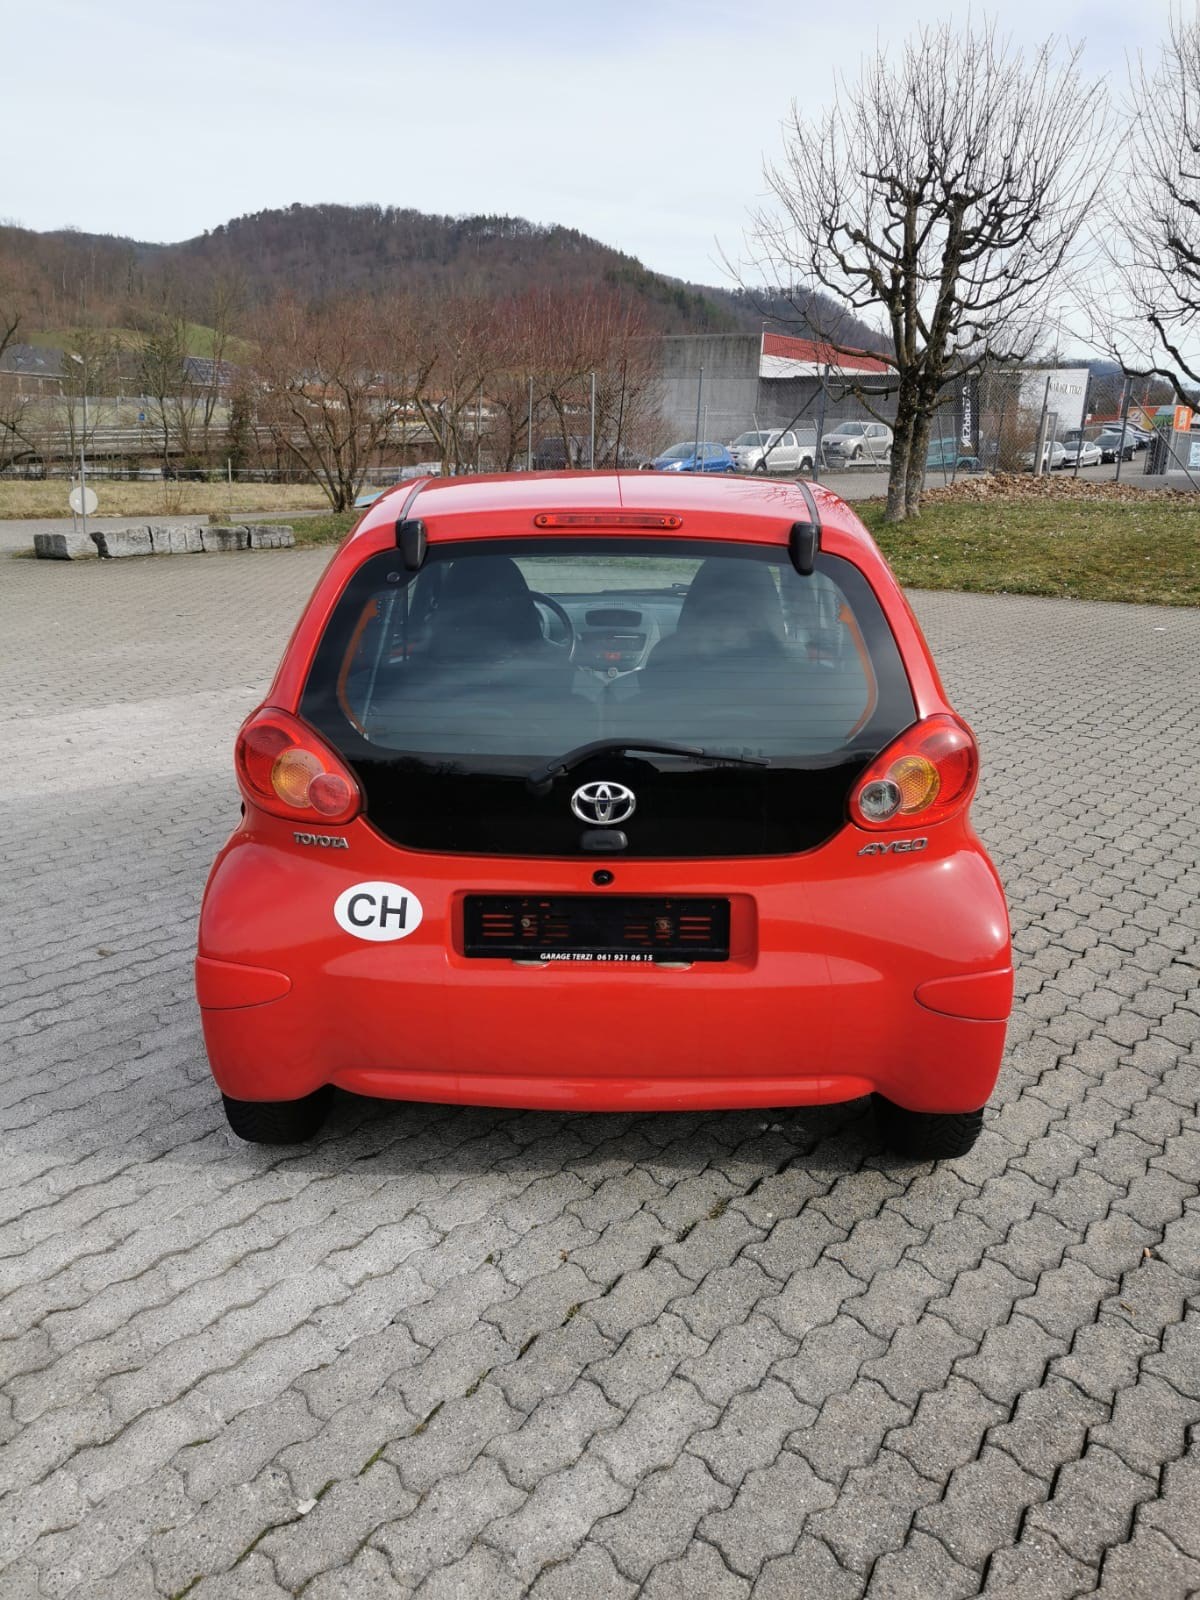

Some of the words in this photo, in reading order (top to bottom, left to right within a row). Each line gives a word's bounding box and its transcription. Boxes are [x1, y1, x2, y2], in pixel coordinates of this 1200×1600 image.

[293, 832, 349, 849] TOYOTA
[857, 837, 928, 855] AYGO
[347, 893, 408, 929] CH
